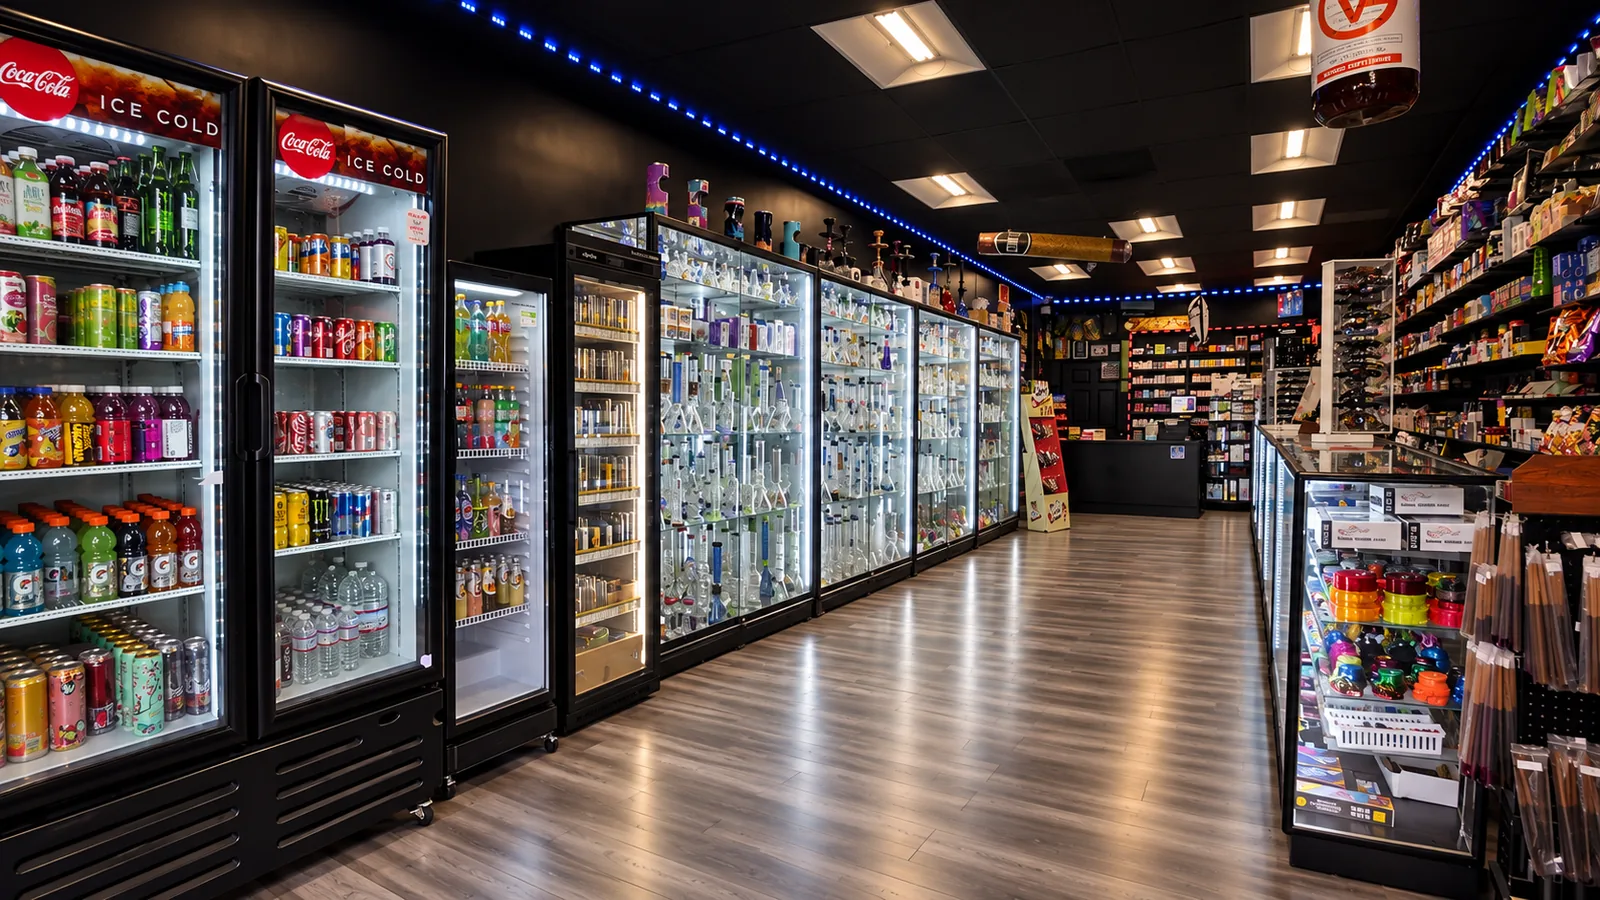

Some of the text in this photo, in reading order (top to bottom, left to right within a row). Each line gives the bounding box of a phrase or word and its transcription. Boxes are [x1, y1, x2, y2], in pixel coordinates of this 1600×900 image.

[0, 62, 75, 98] Coca-Cola
[100, 95, 219, 136] ICE COLD
[281, 132, 333, 160] Coca-Cola
[347, 155, 424, 184] ICE COLD
